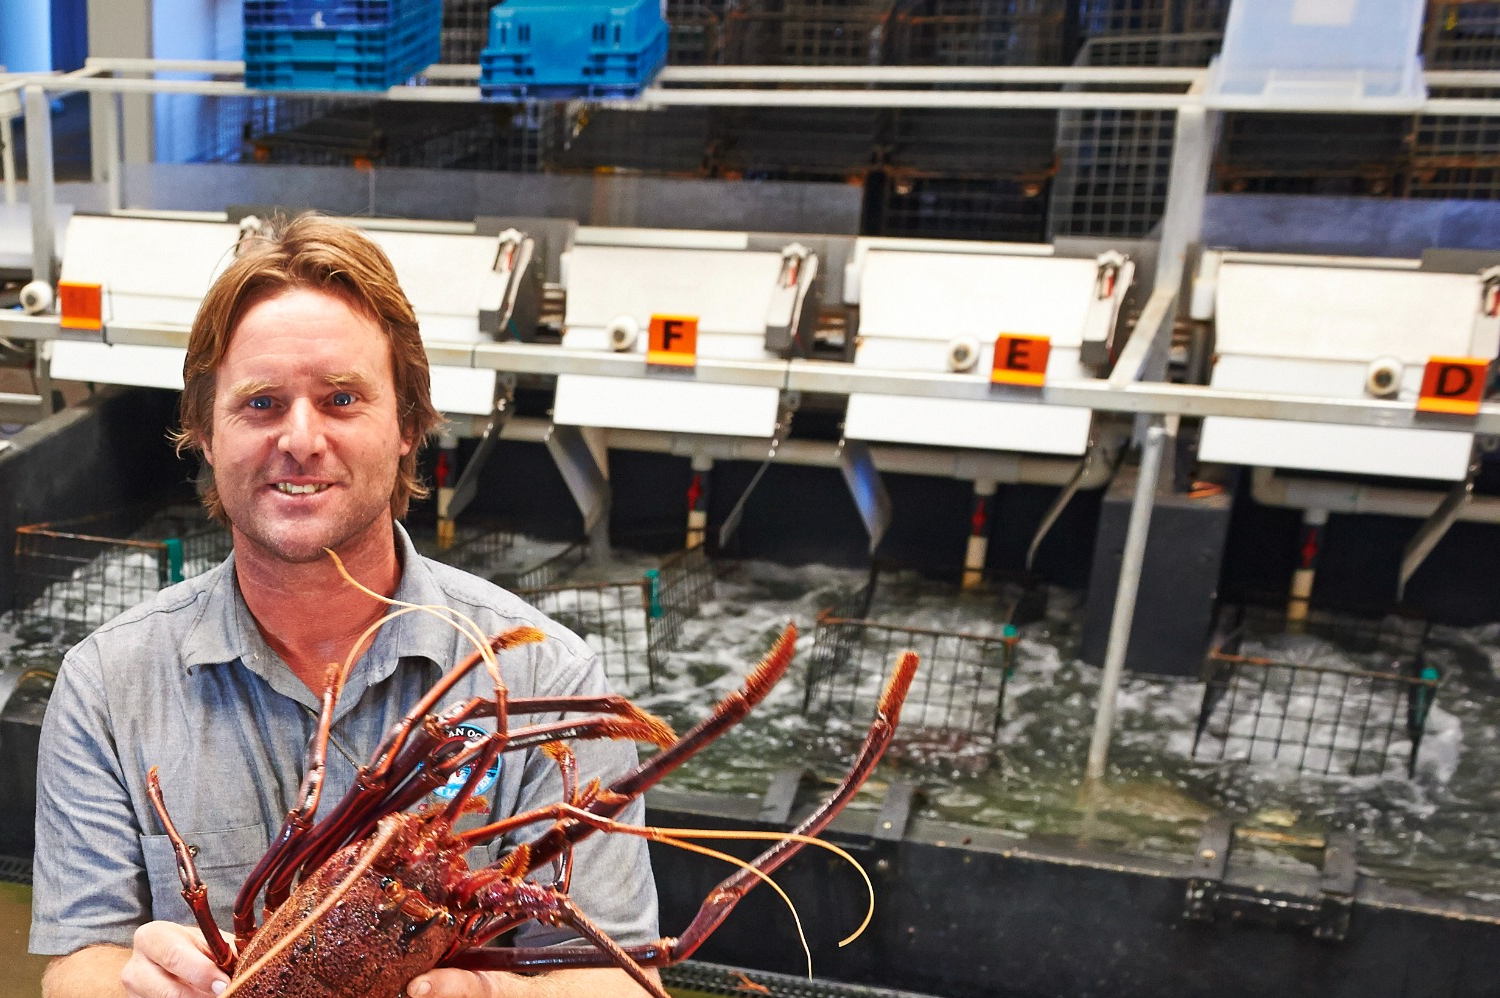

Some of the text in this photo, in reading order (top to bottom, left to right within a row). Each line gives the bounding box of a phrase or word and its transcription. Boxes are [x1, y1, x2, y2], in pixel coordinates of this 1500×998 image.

[663, 320, 684, 350] F
[1006, 338, 1032, 371] E
[1436, 363, 1473, 397] D
